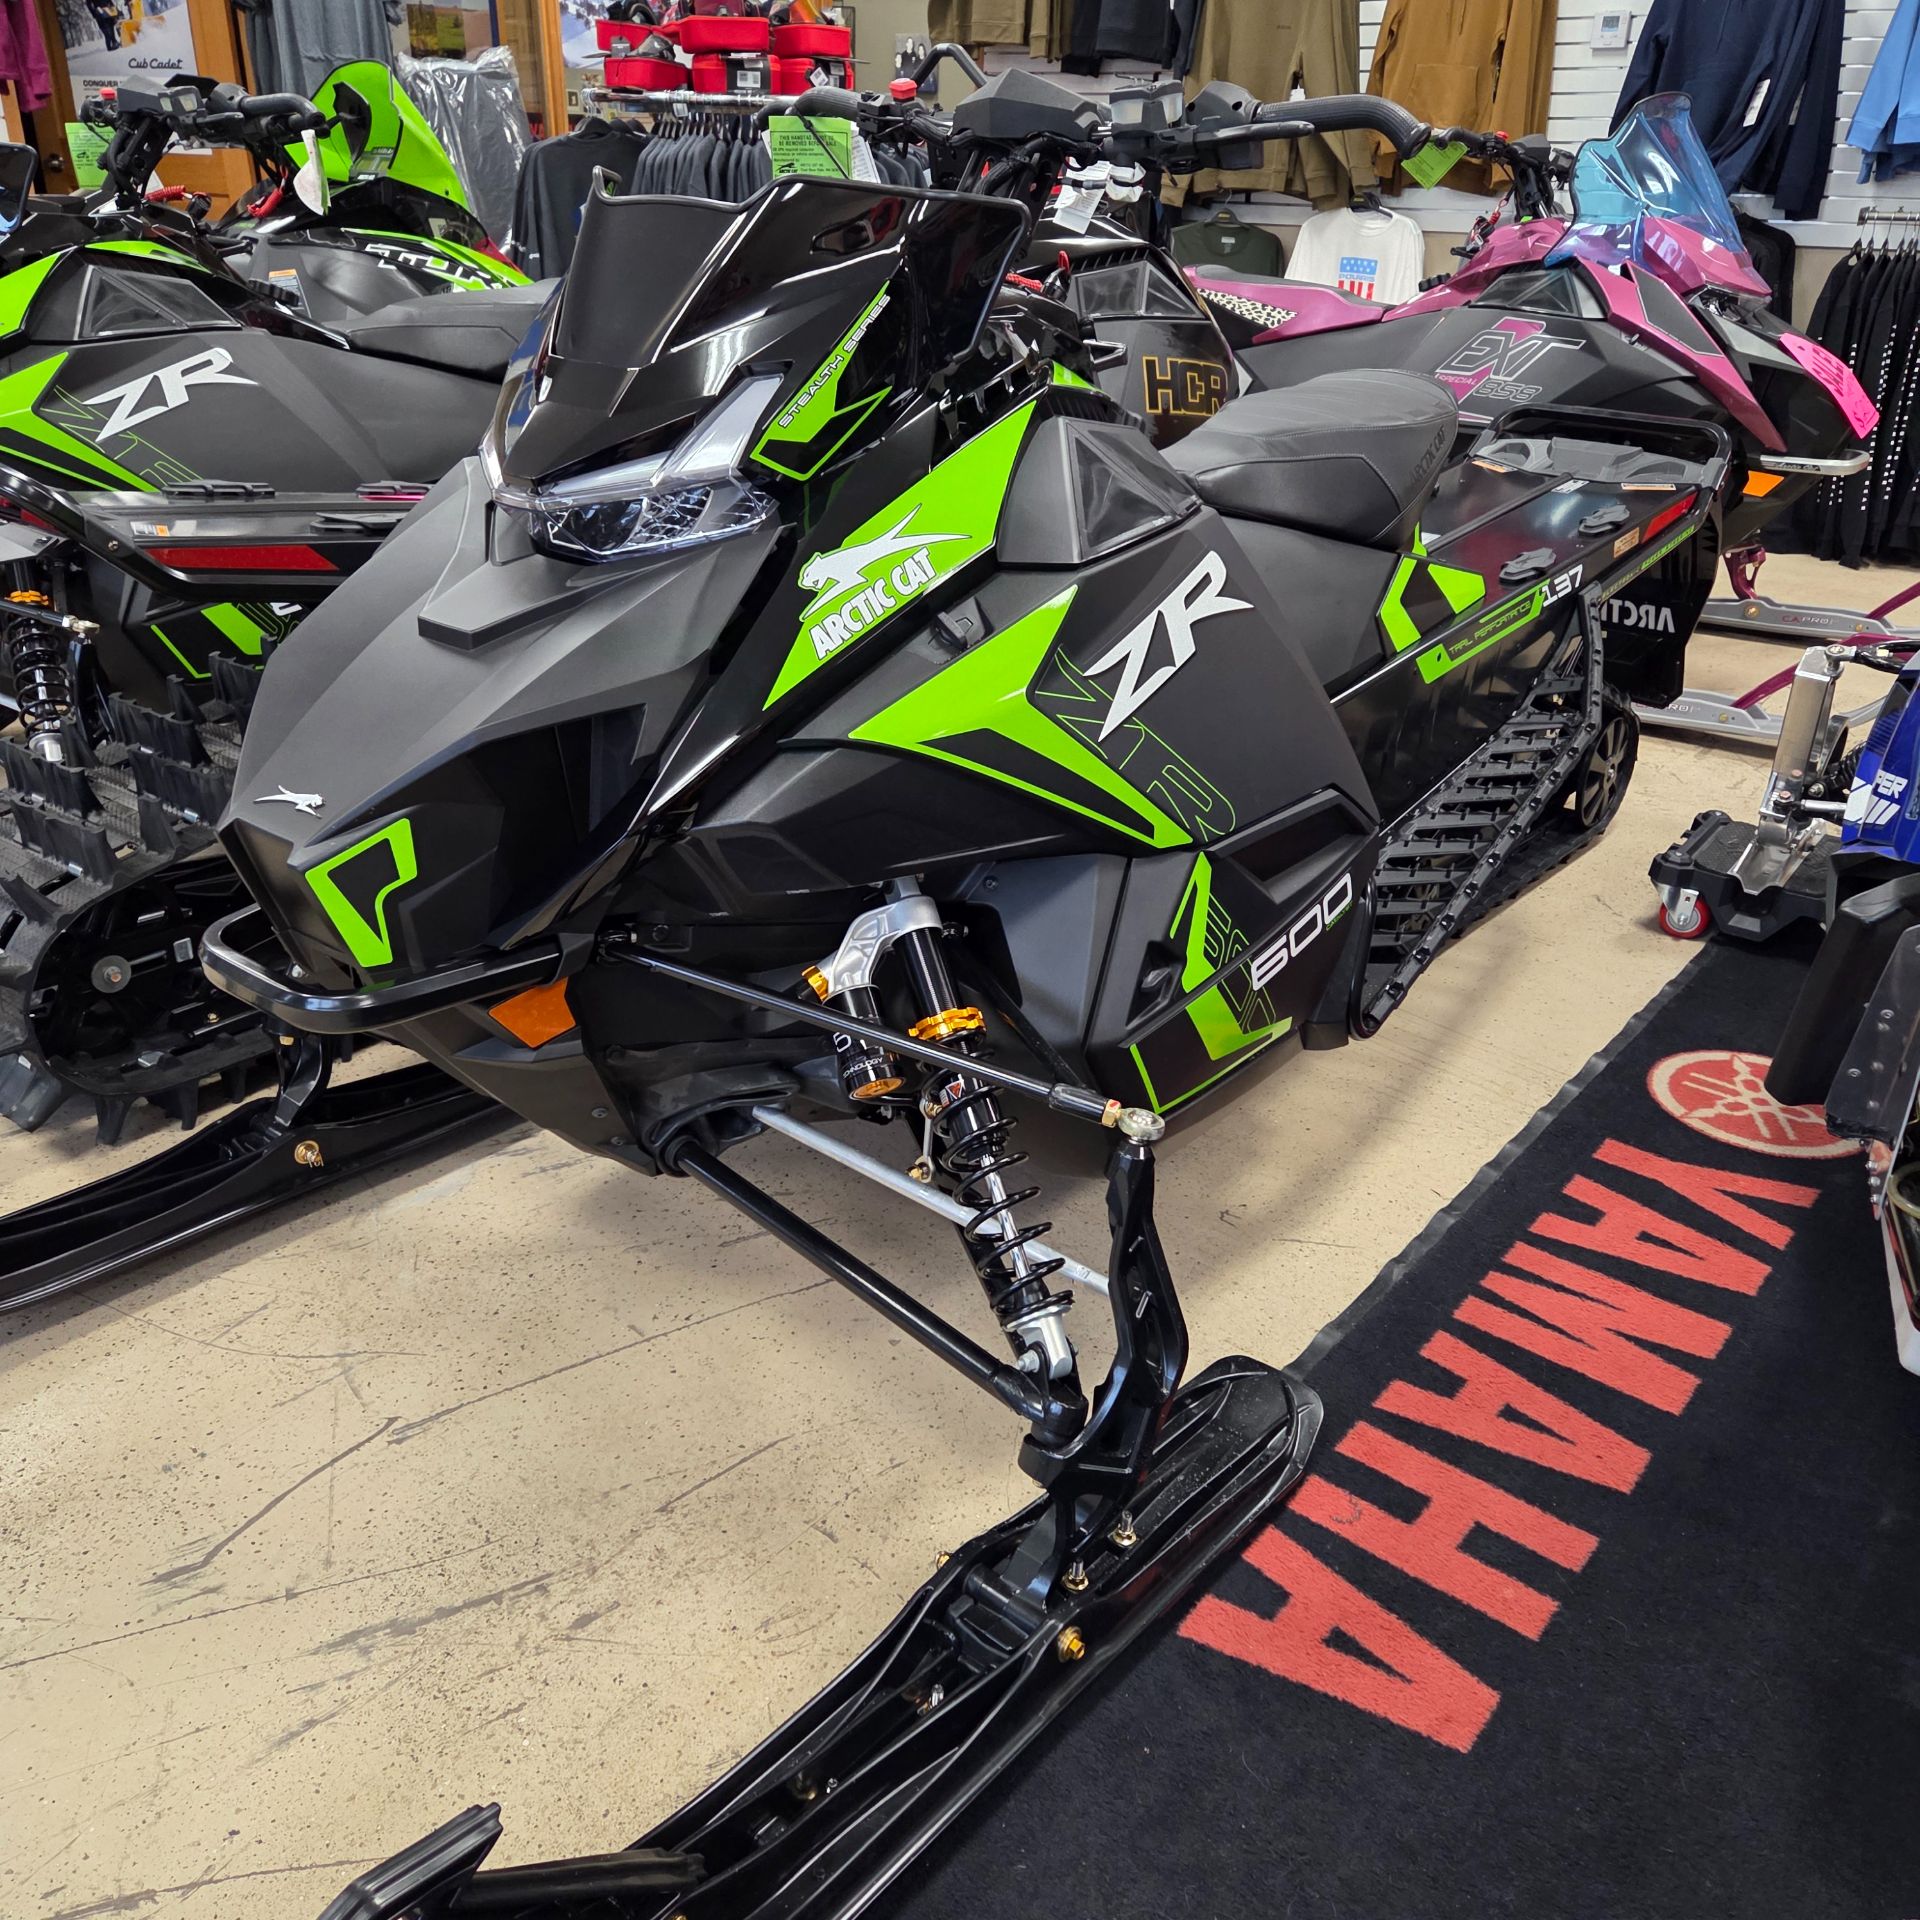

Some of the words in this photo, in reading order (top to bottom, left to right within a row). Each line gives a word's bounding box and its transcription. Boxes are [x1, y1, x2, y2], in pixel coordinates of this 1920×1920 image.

[83, 79, 118, 88] CONQUER
[128, 57, 148, 69] Cub
[149, 59, 183, 70] Cadet
[843, 294, 891, 353] SERIES
[1435, 328, 1587, 382] EXT
[83, 347, 259, 443] ZR
[778, 355, 844, 428] STEALTH
[1142, 356, 1229, 416] HCR
[1473, 380, 1542, 402] 858
[808, 577, 897, 661] ARCTIC
[890, 546, 936, 597] CAT
[1541, 564, 1583, 608] 137
[1082, 550, 1255, 742] ZR
[1252, 873, 1353, 992] 600
[1177, 1137, 1820, 1754] YAMAHA
